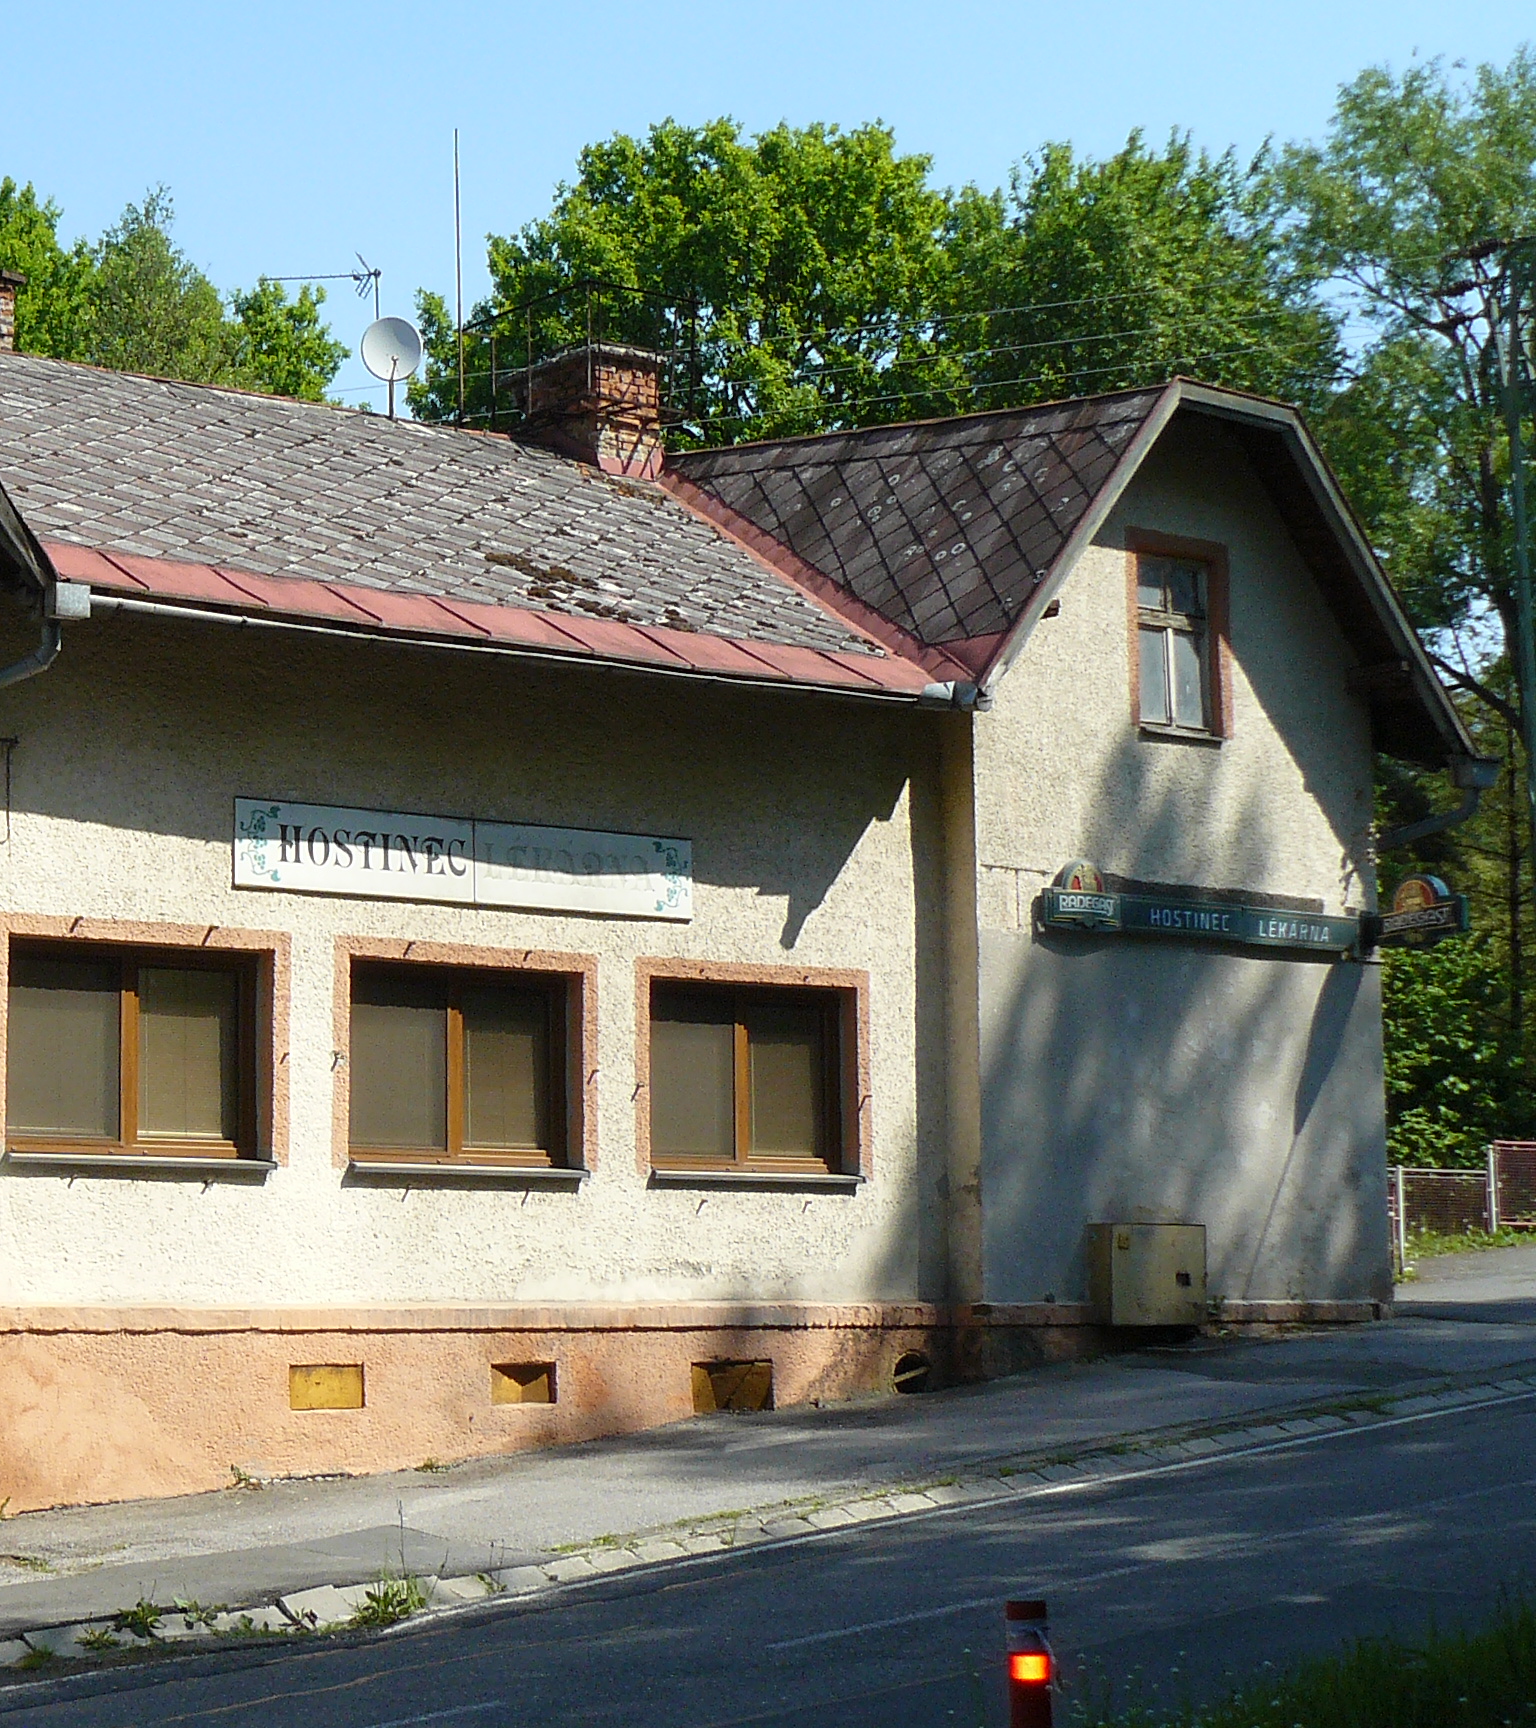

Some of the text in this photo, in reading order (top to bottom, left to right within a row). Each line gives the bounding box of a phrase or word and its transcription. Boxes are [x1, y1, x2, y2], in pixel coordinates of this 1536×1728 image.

[277, 823, 467, 877] HOSTINEC
[1059, 895, 1115, 916] RADEGAST
[1150, 908, 1230, 932] HOSTINEC
